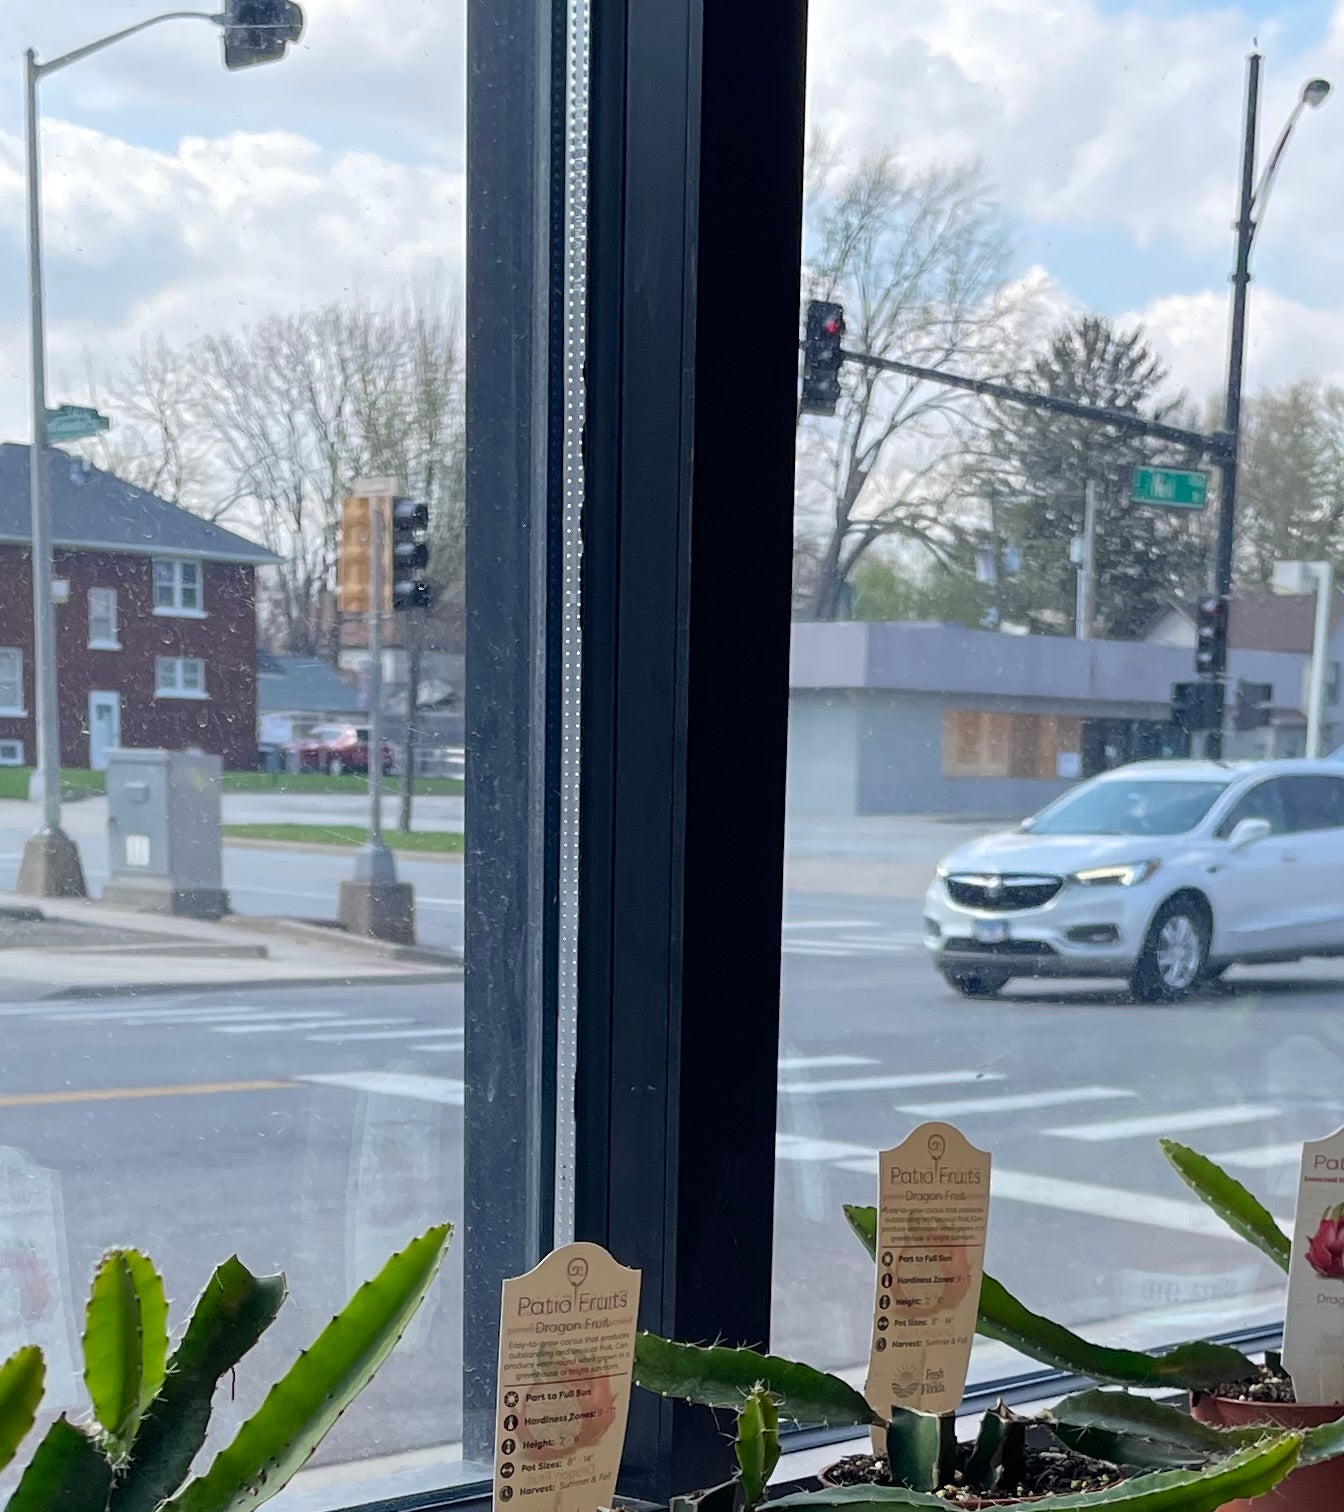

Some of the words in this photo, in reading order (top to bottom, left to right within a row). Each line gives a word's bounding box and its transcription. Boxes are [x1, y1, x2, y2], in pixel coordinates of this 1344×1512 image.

[891, 1166, 934, 1184] Patio
[939, 1166, 981, 1184] Fruits
[906, 1190, 942, 1204] Dragon
[945, 1190, 966, 1201] Fruit
[899, 1255, 914, 1263] Part
[916, 1255, 923, 1263] to
[925, 1255, 938, 1263] Full
[939, 1254, 952, 1263] Sun
[897, 1276, 932, 1285] Hardiness
[518, 1295, 572, 1316] Patio
[579, 1291, 629, 1312] Fruits
[896, 1298, 922, 1308] Height:
[536, 1321, 582, 1335] Dragon
[585, 1318, 610, 1330] Fruit
[894, 1319, 907, 1327] Pot
[908, 1318, 928, 1327] Sizes:
[508, 1340, 559, 1350] Easy-to-grow
[892, 1339, 922, 1348] Harvest:
[926, 1367, 944, 1381] Fresh
[526, 1393, 546, 1402] Part
[548, 1392, 557, 1400] to
[559, 1390, 575, 1399] Full
[576, 1388, 592, 1398] Sun
[524, 1415, 568, 1426] Hardiness
[568, 1410, 596, 1423] Zones:
[523, 1438, 555, 1450] Height:
[521, 1463, 537, 1473] Pot
[538, 1460, 562, 1470] Sizes:
[520, 1484, 555, 1496] Harvest:
[560, 1477, 590, 1490] Summer
[591, 1474, 597, 1483] &
[598, 1472, 613, 1482] Fall
